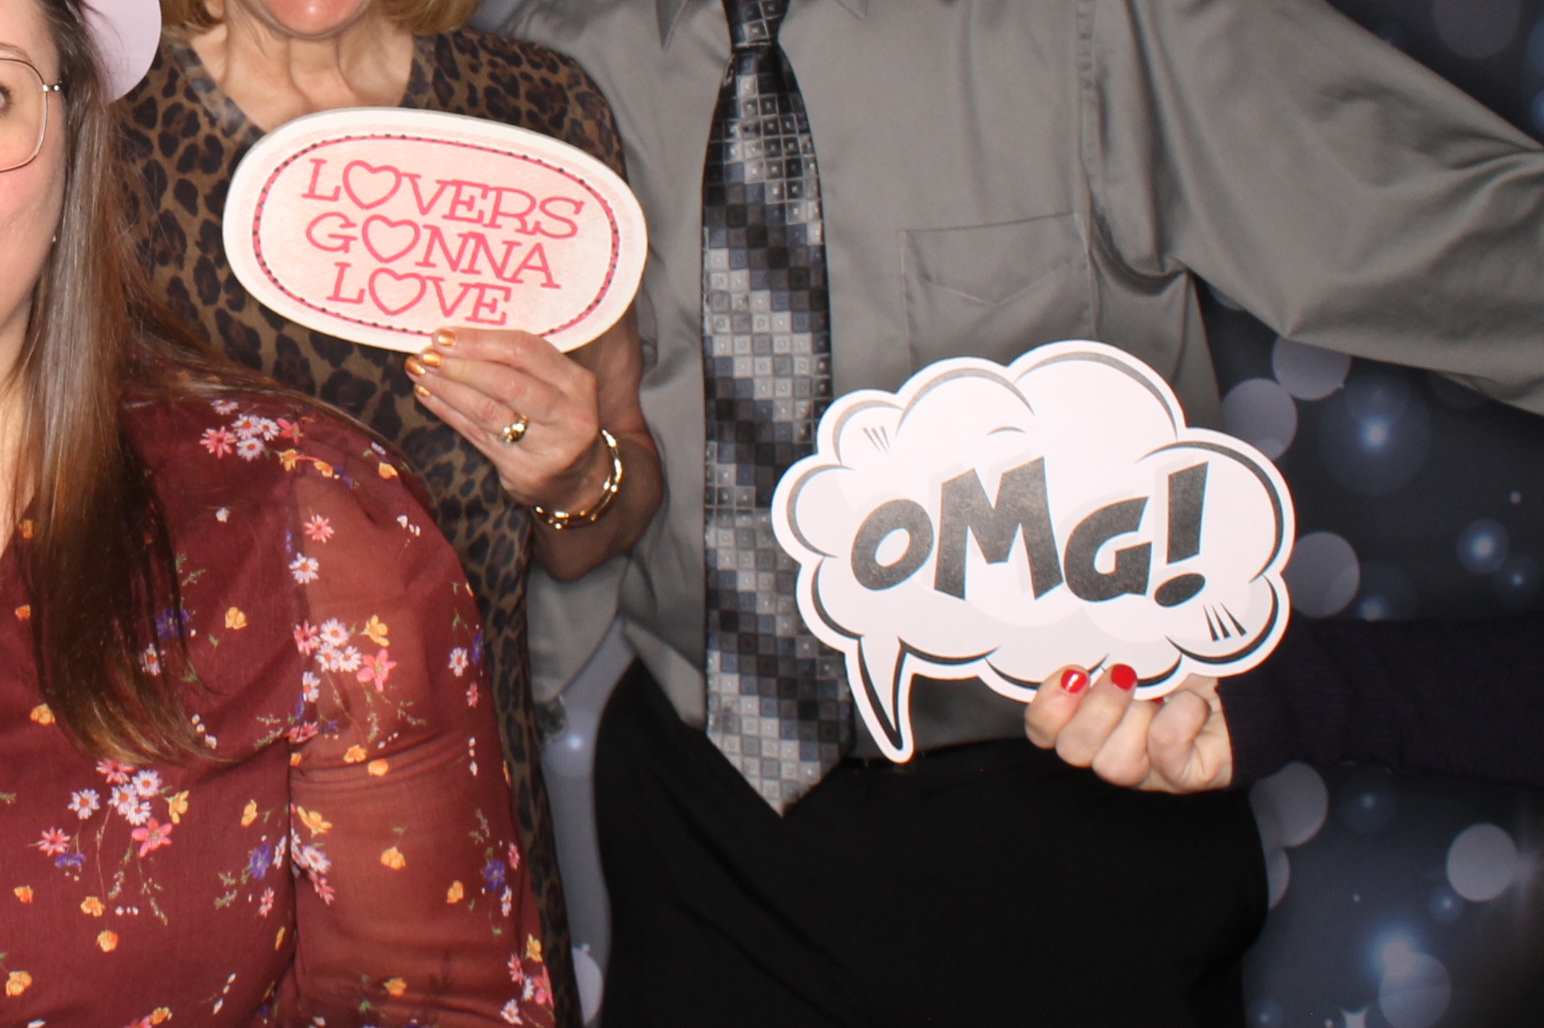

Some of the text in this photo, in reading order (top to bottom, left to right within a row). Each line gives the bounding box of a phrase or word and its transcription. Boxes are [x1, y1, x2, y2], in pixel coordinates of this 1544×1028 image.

[301, 158, 584, 239] LOVERS
[305, 212, 562, 289] GONNA
[326, 262, 512, 326] LOVE
